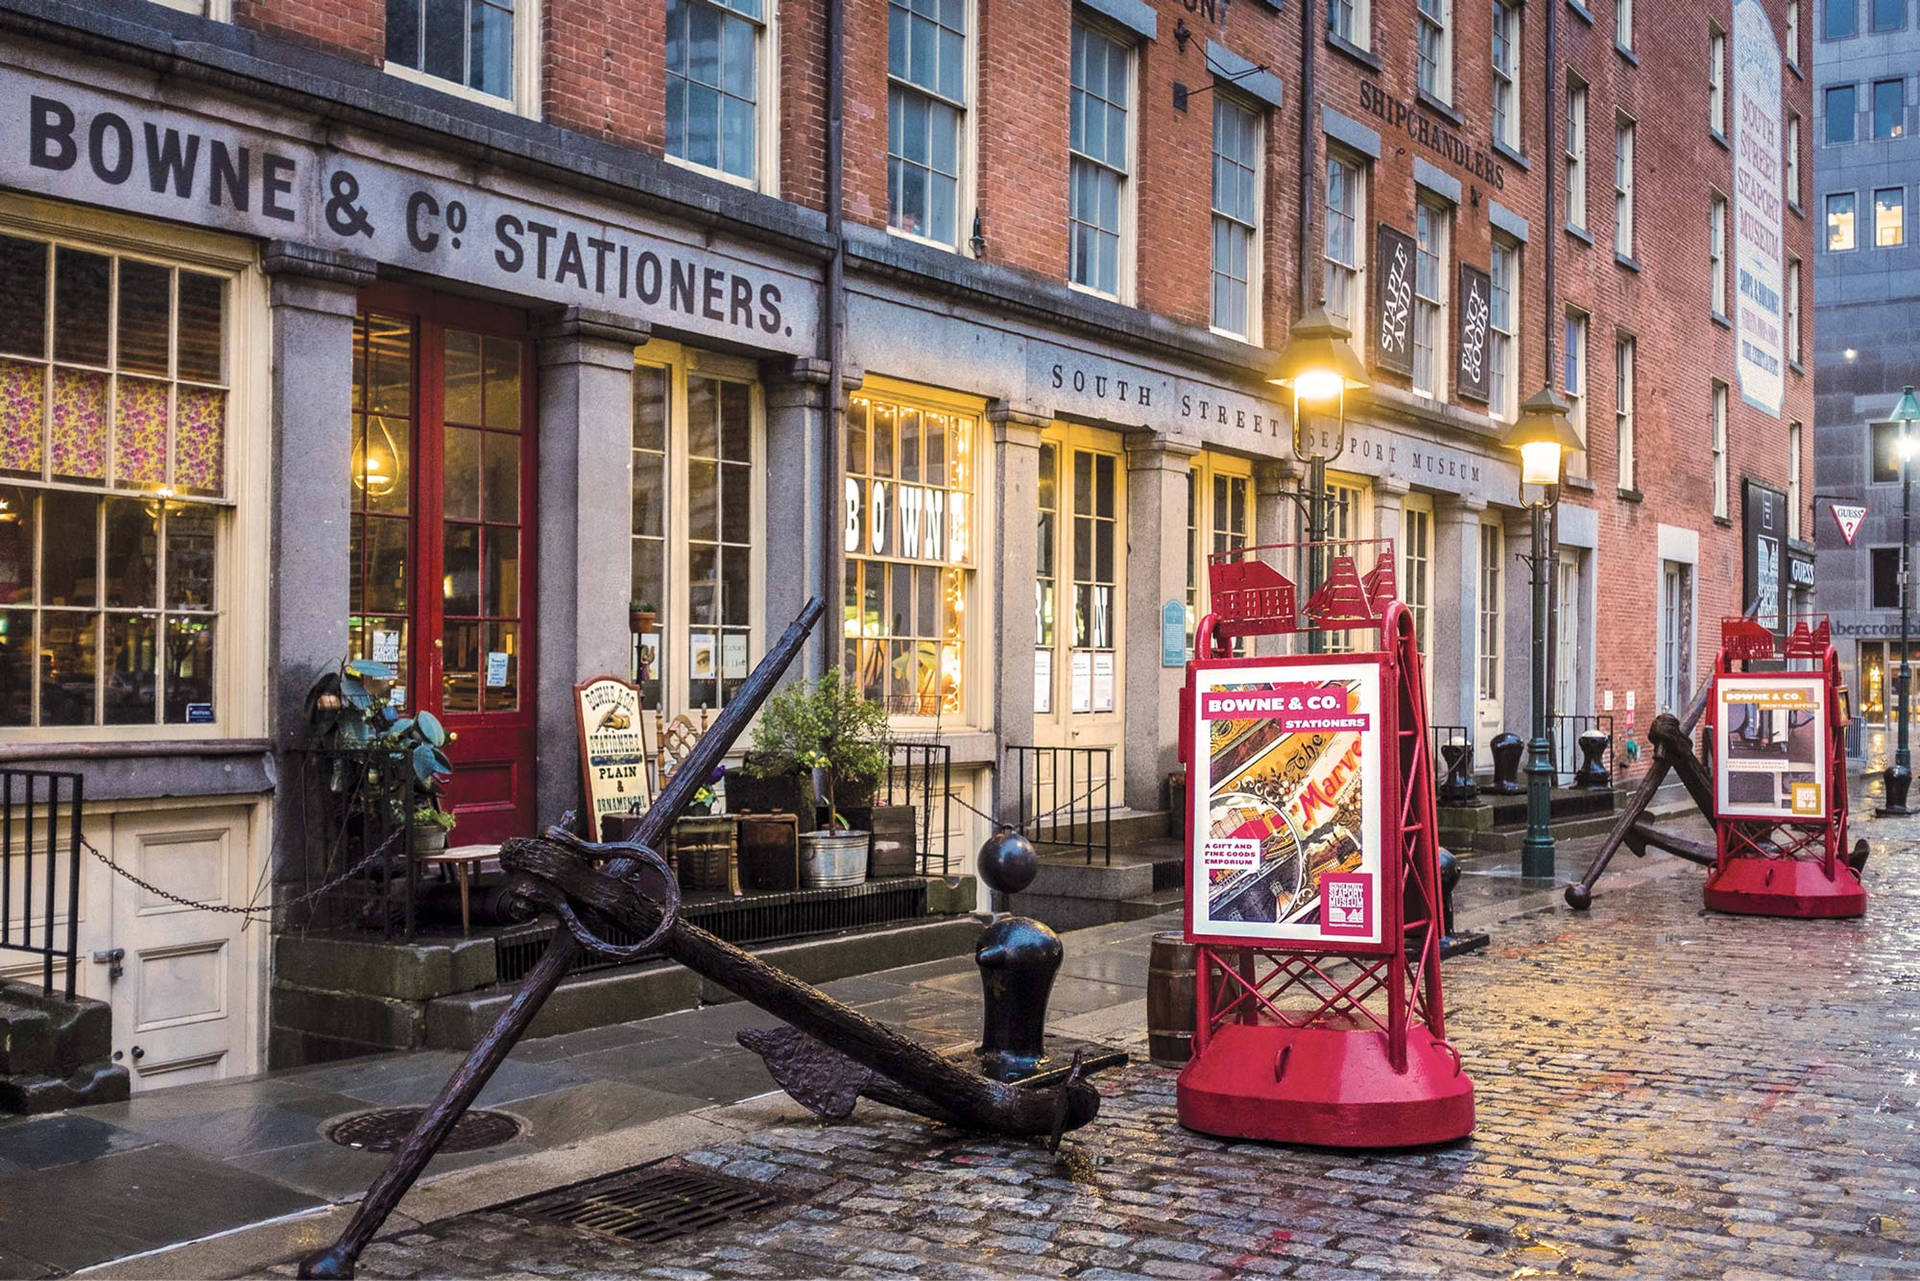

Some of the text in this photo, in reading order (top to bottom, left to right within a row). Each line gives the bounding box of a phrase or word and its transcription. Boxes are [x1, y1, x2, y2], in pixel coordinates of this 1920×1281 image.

[1360, 79, 1505, 191] SHIPCHANDLERS
[1742, 92, 1774, 148] SOUTH
[1740, 129, 1776, 185] STREET
[30, 94, 296, 222] BOWNE
[325, 170, 375, 239] &
[495, 214, 793, 338] STATIONERS.
[1738, 166, 1779, 225] SEAPORT
[1739, 206, 1779, 262] MUSEUM
[1381, 242, 1409, 353] STAPLE
[1394, 280, 1412, 353] AND
[1461, 278, 1482, 373] FANCY
[1471, 298, 1489, 384] GOODS
[1052, 364, 1151, 407] SOUTH
[1182, 395, 1280, 438] STREET
[1412, 453, 1480, 482] MUSEUM
[1792, 559, 1815, 585] GUESS
[1208, 695, 1341, 713] BOWNE & CO.
[1285, 718, 1365, 729] STATIONERS
[1726, 693, 1770, 701] BOWNE
[590, 734, 641, 755] STATIONERS
[599, 766, 638, 779] PLAIN
[1285, 734, 1326, 770] The
[617, 780, 625, 792] &
[1329, 888, 1363, 898] SEAPORT
[1329, 897, 1363, 907] MUSEUM
